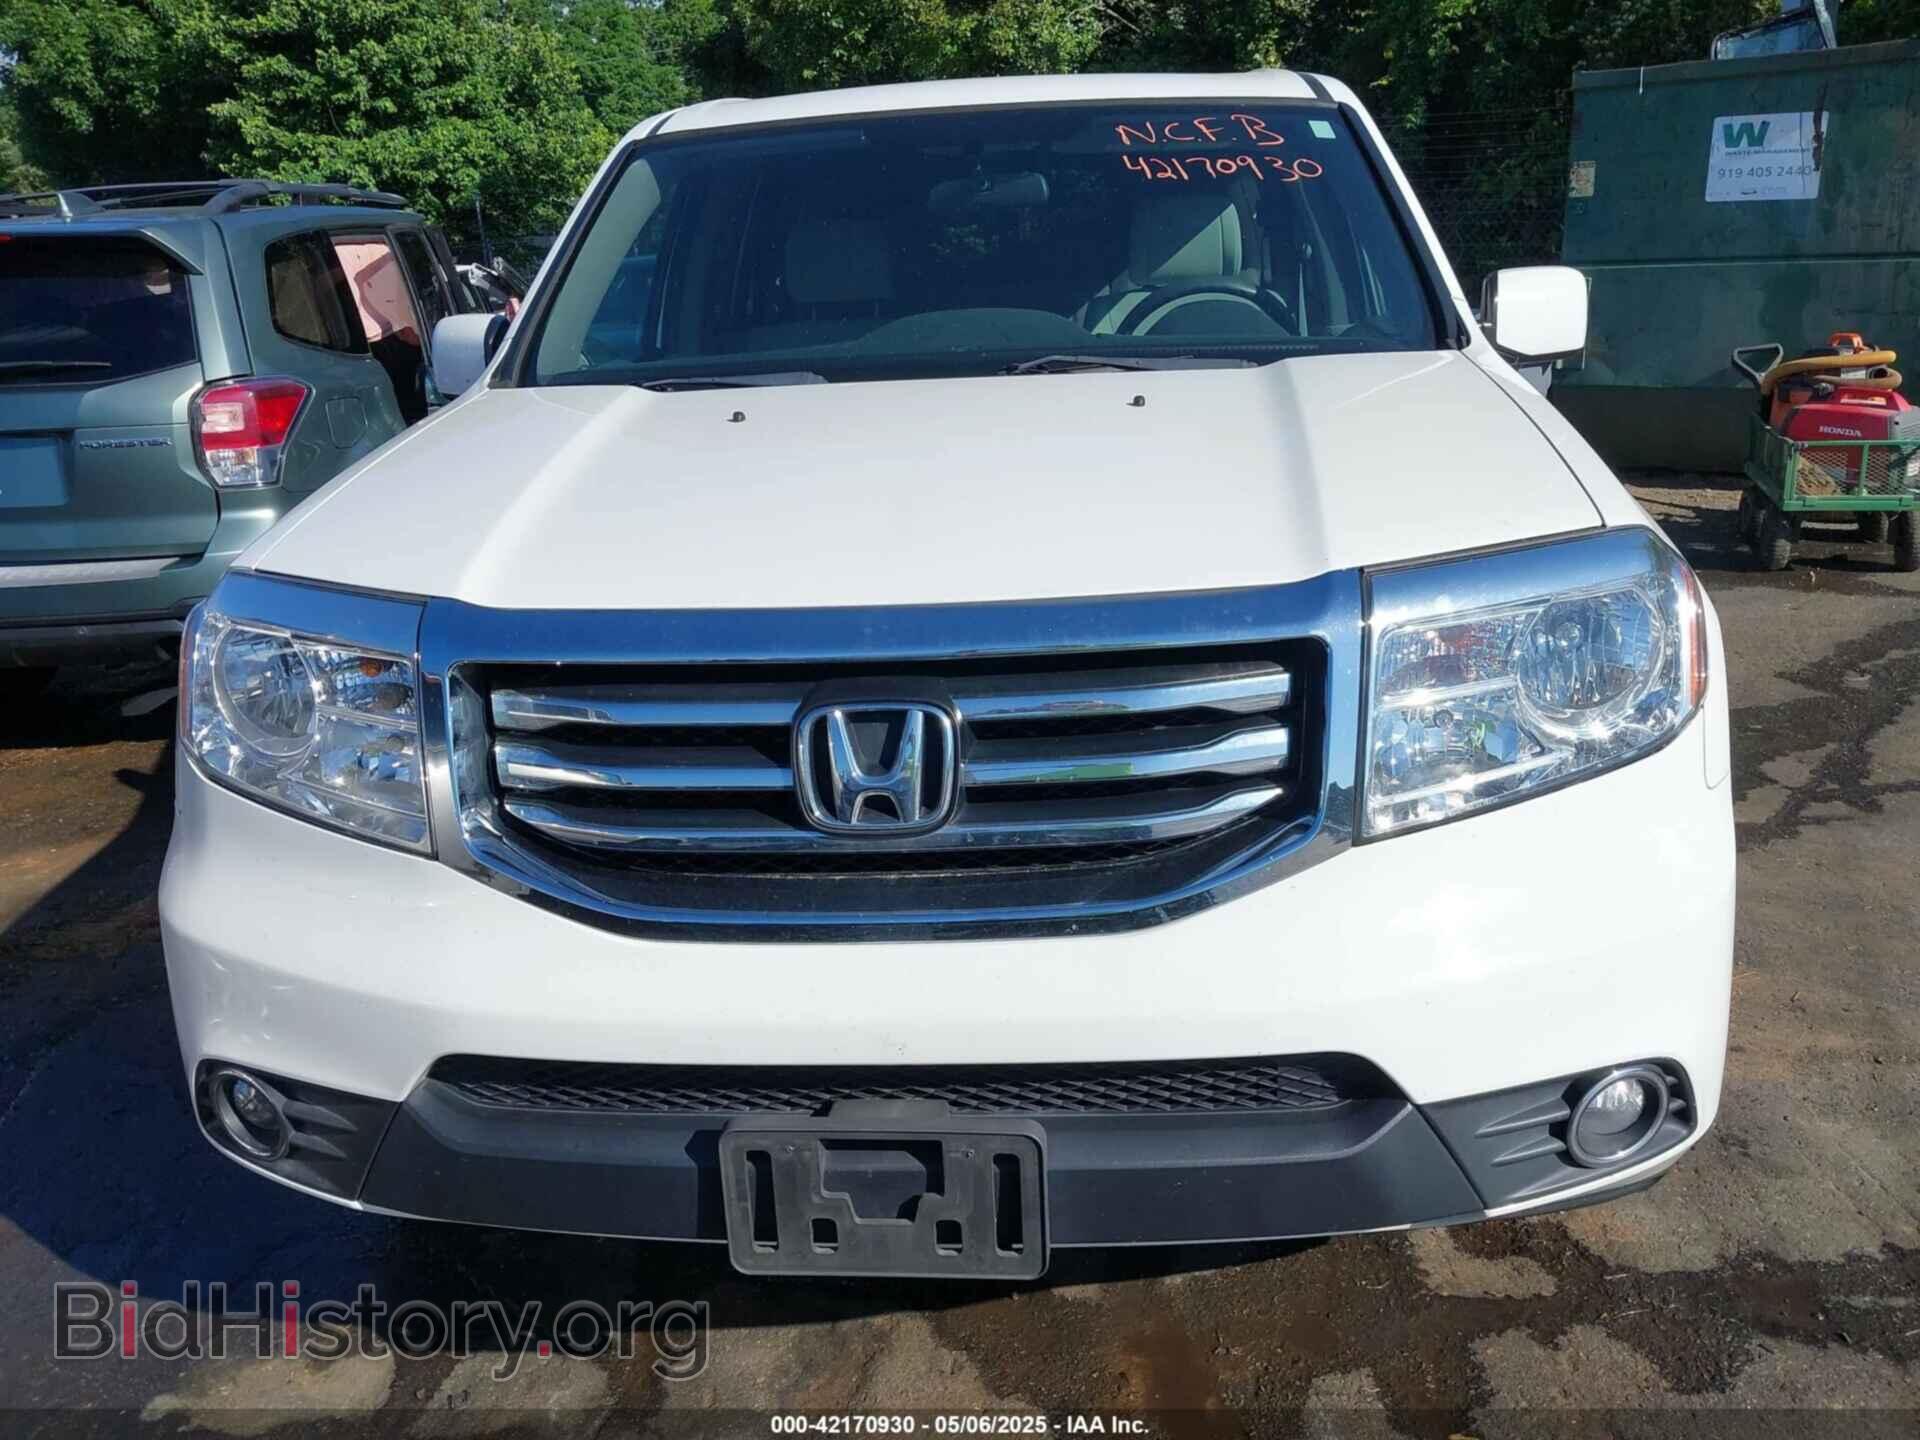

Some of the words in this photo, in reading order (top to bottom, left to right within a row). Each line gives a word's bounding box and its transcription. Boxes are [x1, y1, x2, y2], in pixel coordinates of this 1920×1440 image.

[1122, 155, 1323, 182] 42170930
[1718, 167, 1743, 179] 919
[1747, 166, 1773, 177] 405
[1818, 425, 1862, 437] HONDA
[79, 437, 174, 449] FORESTER
